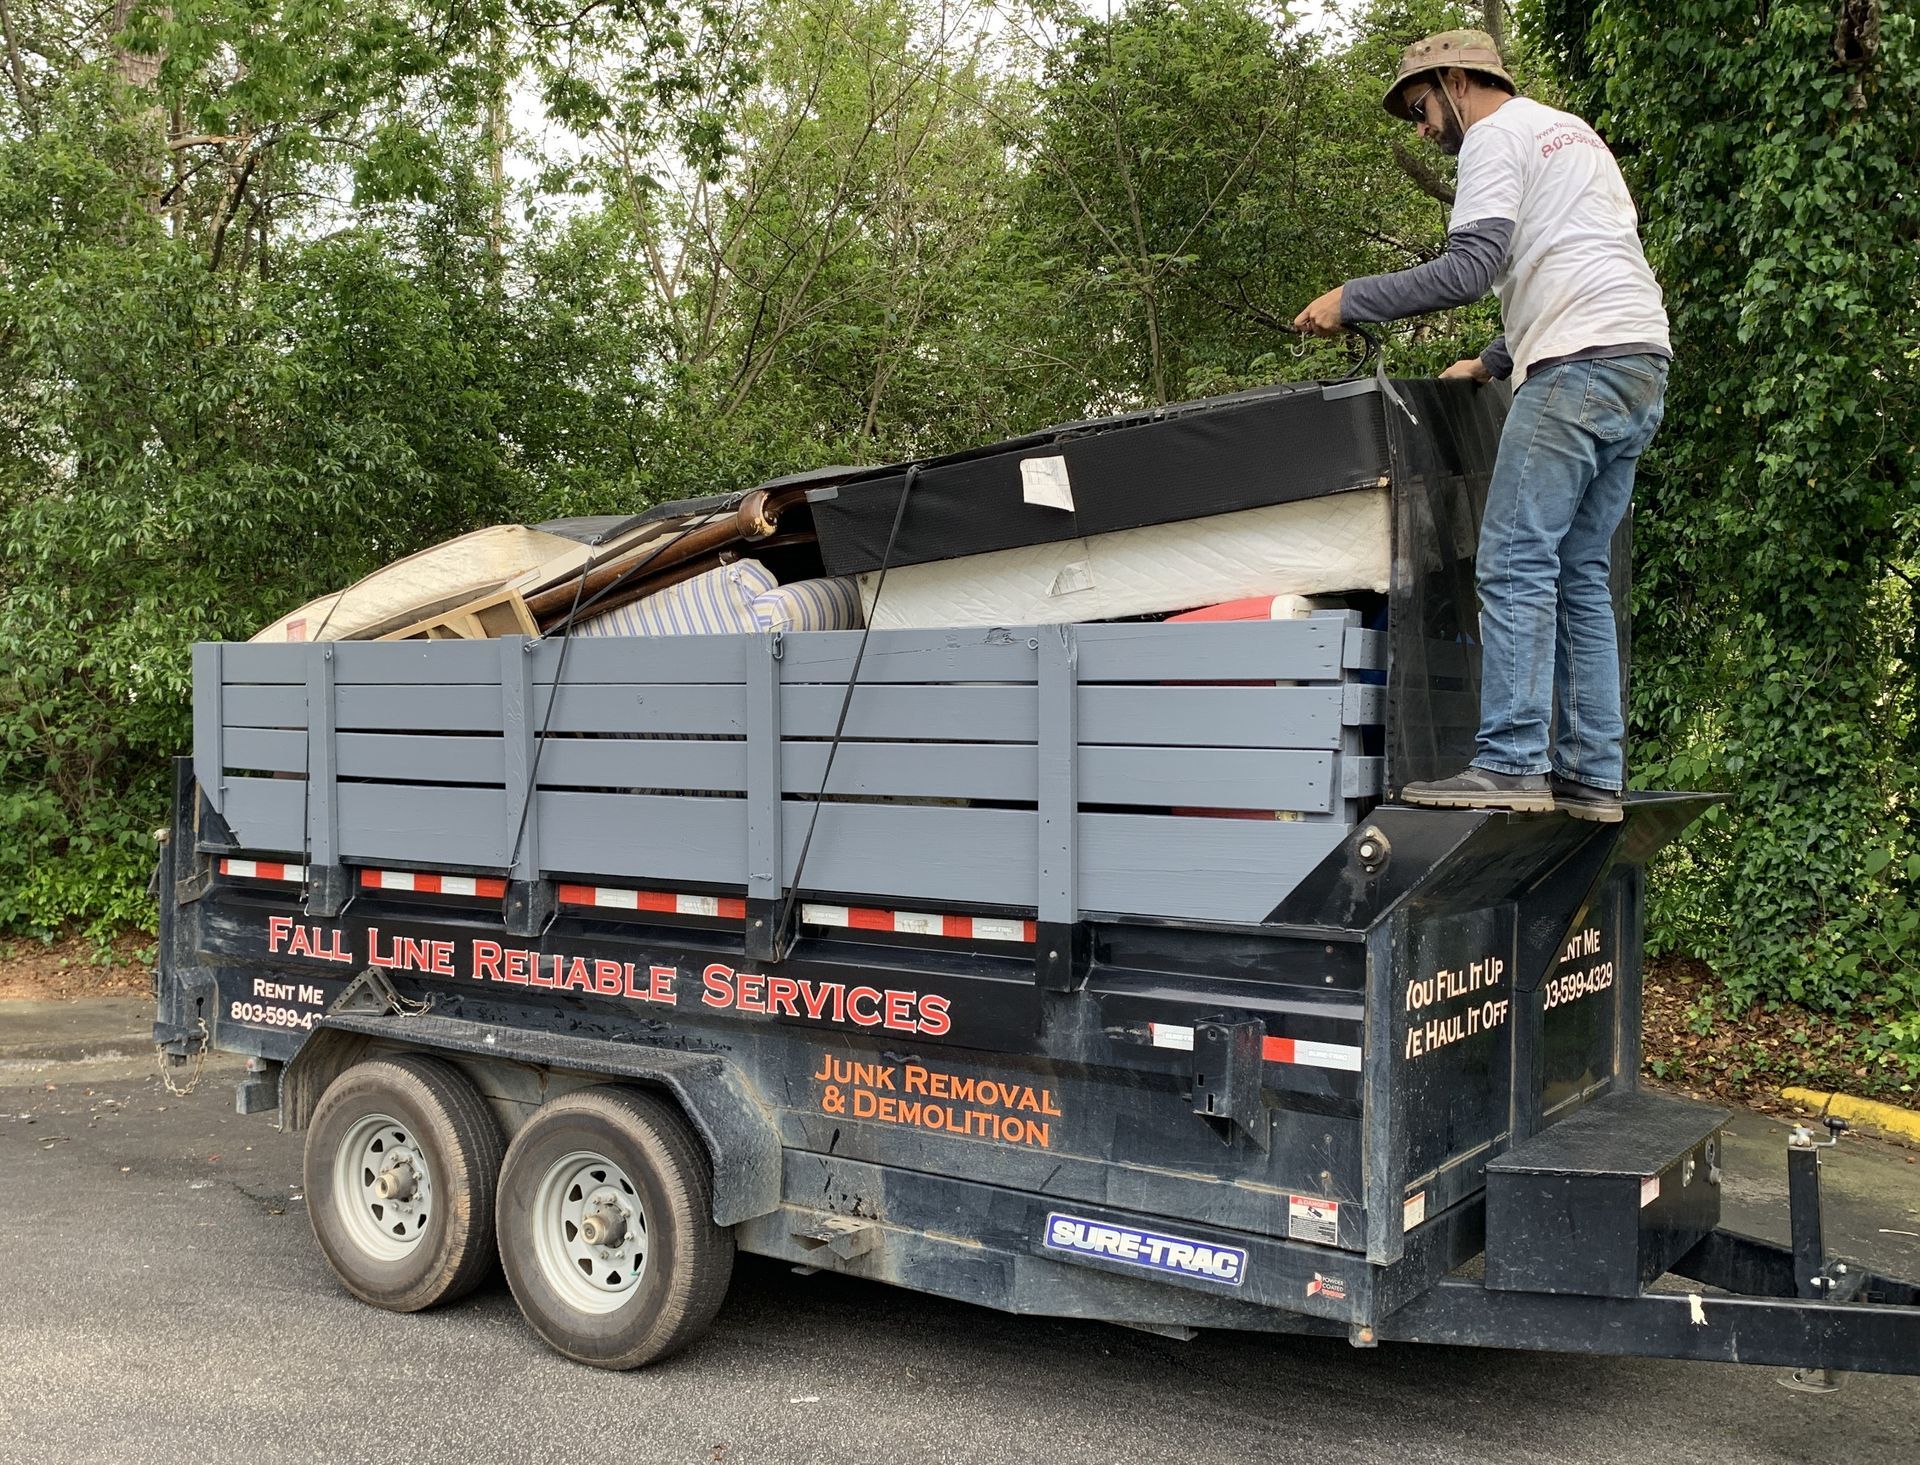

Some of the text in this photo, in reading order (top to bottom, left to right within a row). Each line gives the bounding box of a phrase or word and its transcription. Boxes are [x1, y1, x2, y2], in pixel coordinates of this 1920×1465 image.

[1584, 928, 1601, 955] ME
[253, 978, 324, 1005] RENT ME
[269, 916, 951, 1036] FALL LINE RELIABLE SERVICES
[1437, 969, 1467, 1001] FILL
[1470, 962, 1482, 991] IT
[1485, 957, 1503, 986] UP
[1426, 1016, 1465, 1052] HAUL
[1468, 1007, 1480, 1035] IT
[1482, 999, 1508, 1029] OFF
[814, 1054, 1062, 1116] JUNK REMOVAL
[822, 1085, 1050, 1148] & DEMOLITION
[1051, 1219, 1239, 1280] SURE-TRAC
[1322, 1283, 1344, 1292] COATED
